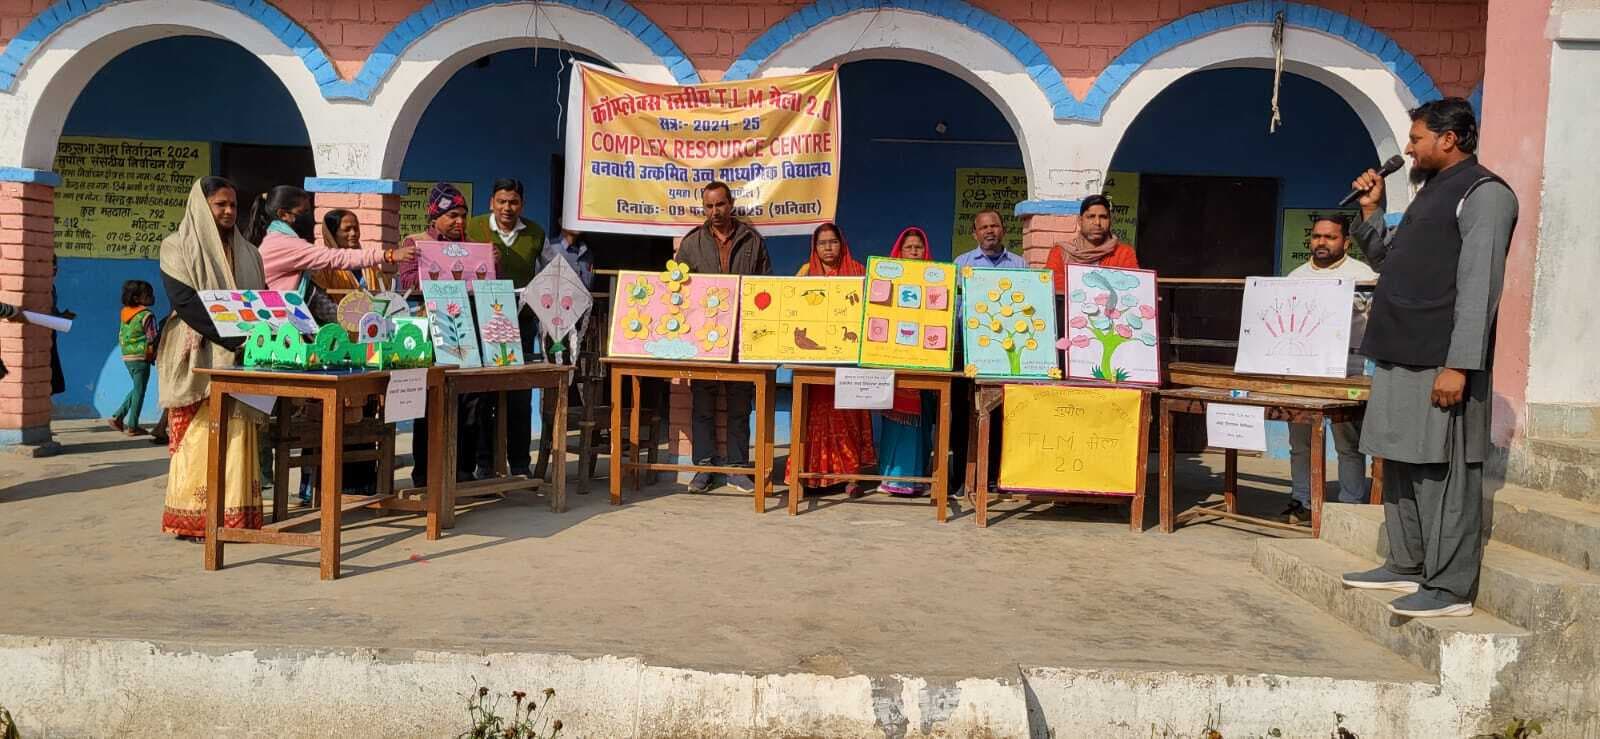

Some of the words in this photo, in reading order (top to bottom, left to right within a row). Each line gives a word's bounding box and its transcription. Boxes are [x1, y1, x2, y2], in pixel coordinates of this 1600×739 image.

[664, 87, 711, 110] स्तरीय
[769, 85, 801, 112] मेला
[807, 96, 832, 121] 2.0
[693, 120, 730, 132] 2024
[743, 117, 760, 130] 25
[167, 146, 199, 160] 2024
[591, 132, 668, 157] COMPLEX
[673, 139, 764, 160] RESOURCE
[769, 132, 832, 156] CENTRE
[592, 161, 635, 179] बनवारी
[720, 163, 778, 182] माध्यमिक
[782, 161, 832, 179] विद्यालय
[149, 208, 165, 219] 792
[769, 200, 821, 216] (शनिवार)
